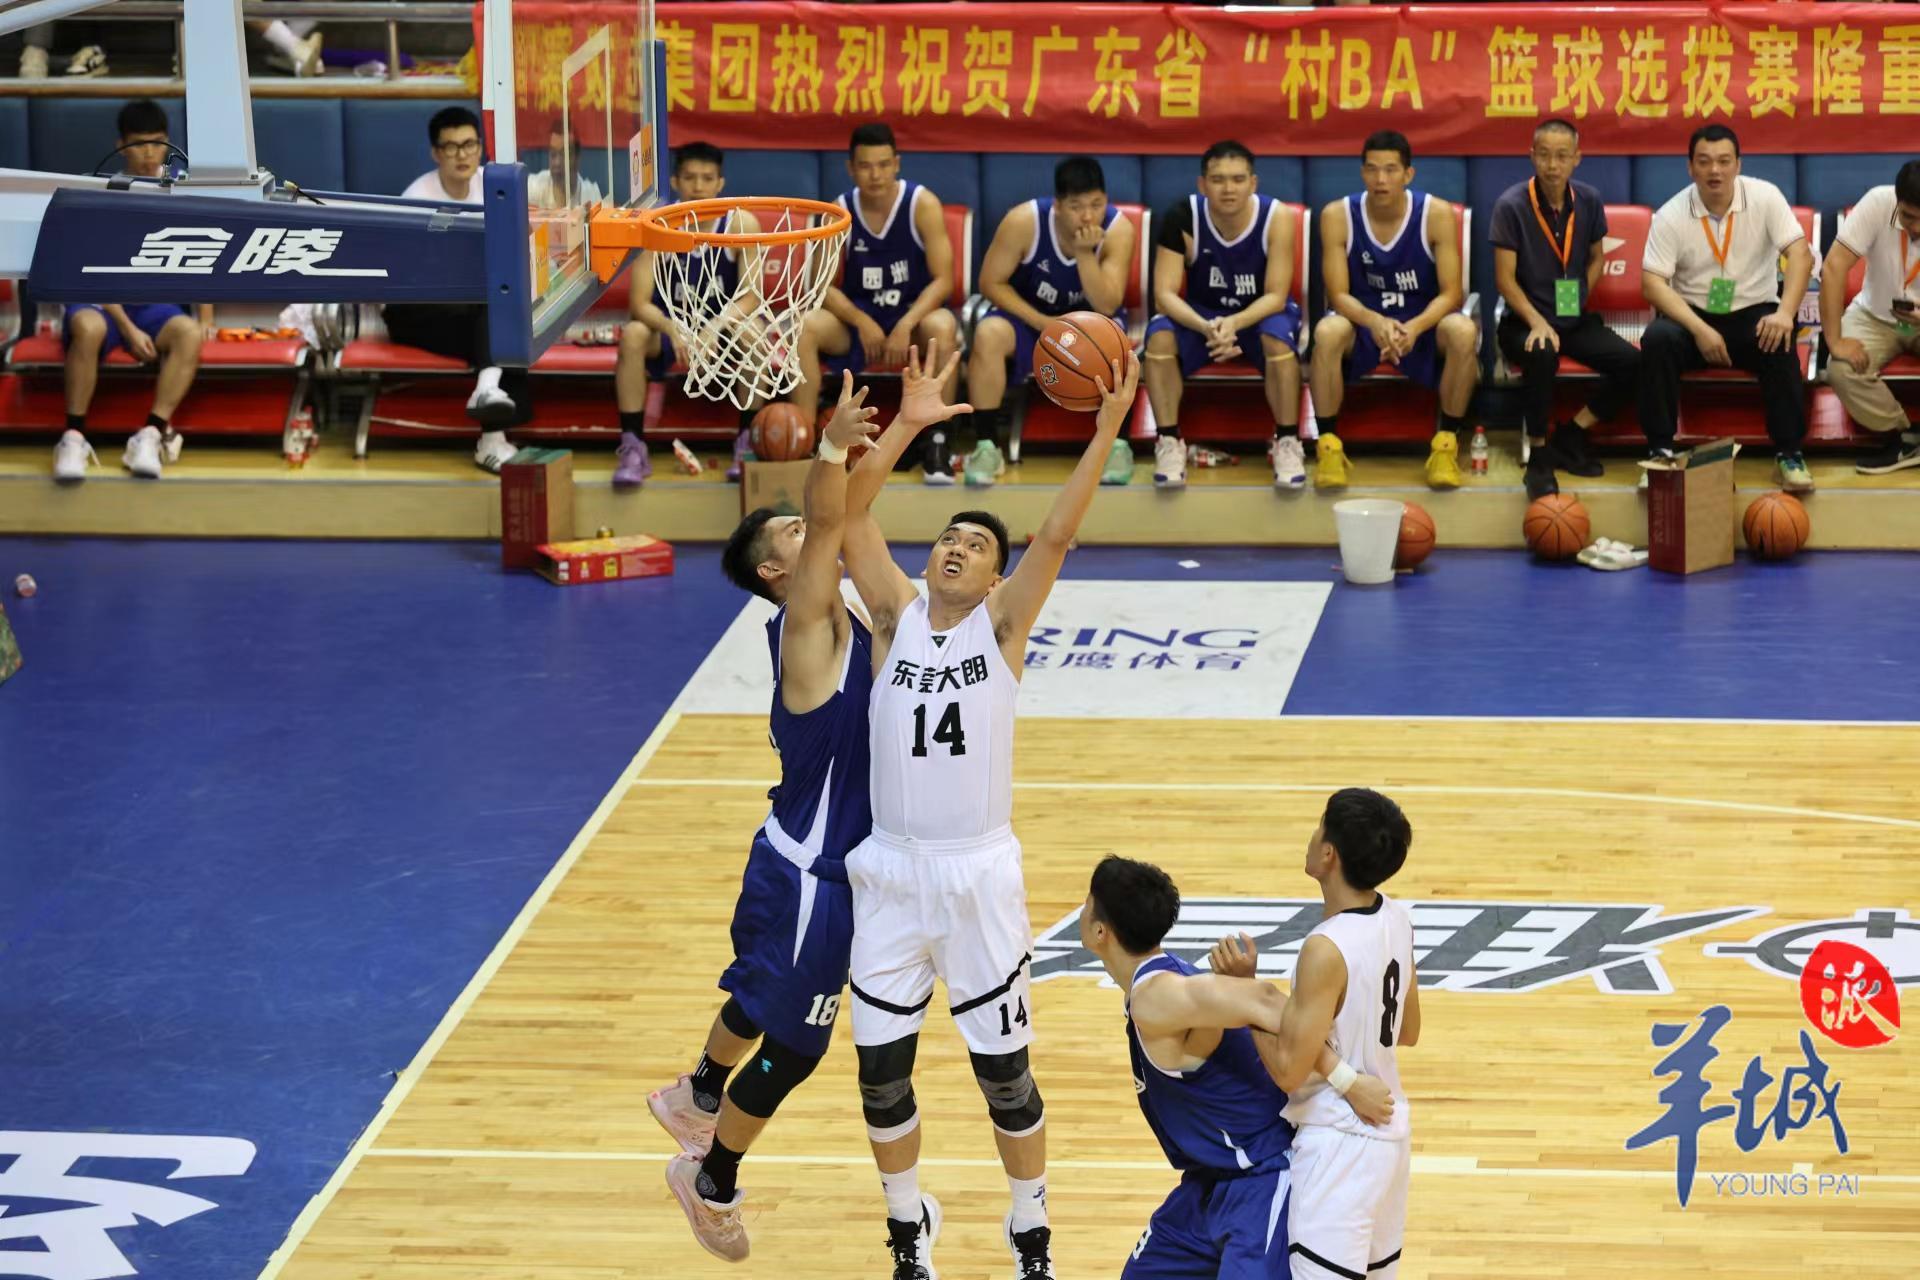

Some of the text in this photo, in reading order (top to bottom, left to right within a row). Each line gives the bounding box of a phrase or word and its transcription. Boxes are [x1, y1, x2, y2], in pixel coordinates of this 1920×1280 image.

[82, 227, 389, 277] 金陵
[891, 654, 989, 694] 东莞大朗
[912, 701, 967, 758] 14
[804, 993, 841, 1027] 18
[999, 994, 1028, 1037] 14
[1379, 957, 1401, 1048] 8
